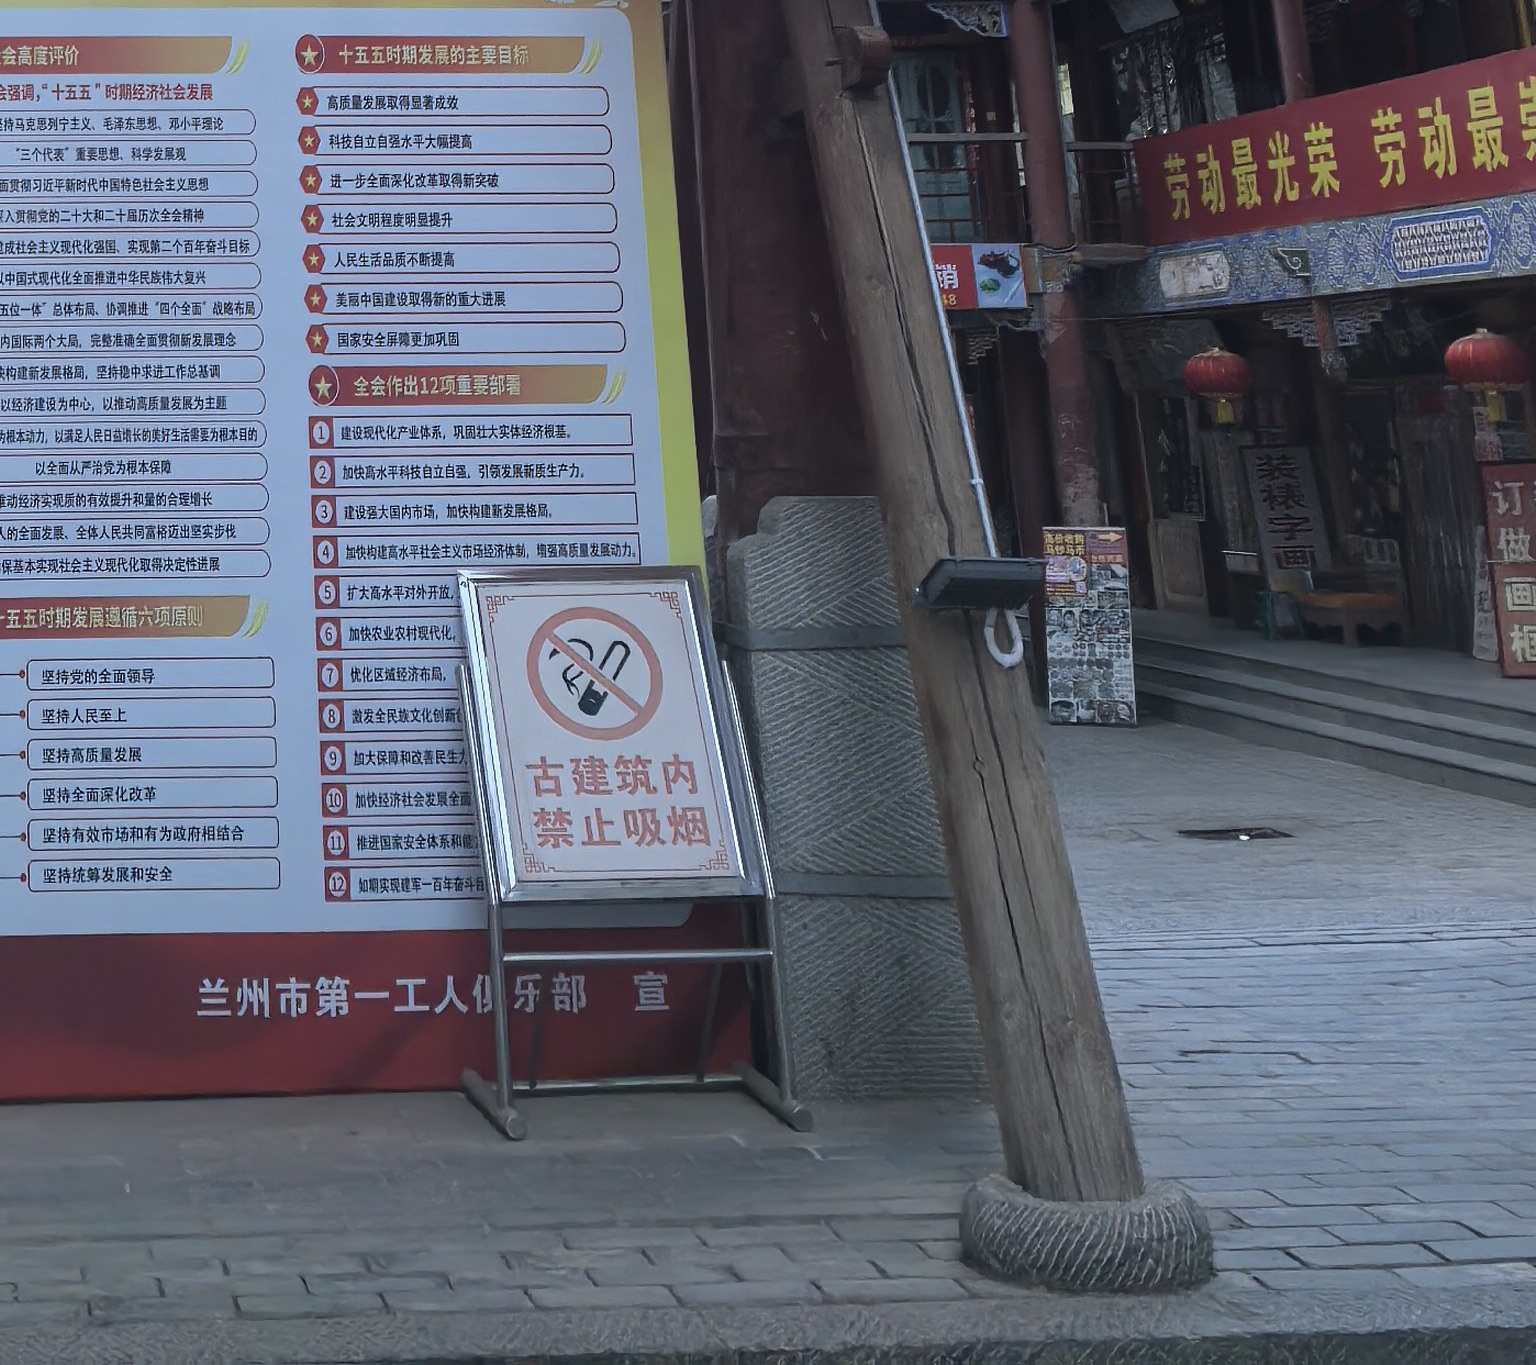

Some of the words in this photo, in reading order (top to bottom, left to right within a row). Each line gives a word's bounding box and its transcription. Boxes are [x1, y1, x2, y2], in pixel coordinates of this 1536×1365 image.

[339, 44, 530, 65] 十五五时期发展的主要目标
[326, 95, 459, 110] 高质量发展取得显著成效
[329, 134, 473, 150] 科技自立自强水平大幅提高
[1164, 121, 1340, 220] 劳动最光荣
[330, 173, 499, 189] 进一步全面深化改革取得新突破
[331, 212, 453, 229] 社会文明程度明显提升
[334, 251, 455, 268] 人民生活品质不断提高
[335, 291, 506, 308] 美丽中国建设取得新的重大进展
[337, 332, 460, 348] 国家安全屏障更加巩固
[354, 374, 522, 398] 全会作出12项重要部署
[318, 426, 325, 440] 1
[35, 460, 172, 475] 以全面从严治党为根本保障
[318, 465, 327, 479] 2
[320, 505, 328, 519] 3
[1256, 453, 1317, 569] 装裱字画
[322, 545, 330, 559] 4
[323, 585, 332, 599] 5
[325, 627, 332, 641] 6
[41, 668, 155, 685] 坚持党的全面领导
[326, 669, 334, 684] 7
[42, 707, 127, 725] 坚持人民至上
[328, 710, 336, 724] 8
[42, 746, 142, 763] 坚持高质量发展
[329, 751, 337, 766] 9
[525, 754, 699, 798] 古建筑内
[43, 786, 157, 804] 坚持全面深化改革
[328, 792, 340, 807] 10
[43, 826, 244, 844] 坚持有效市场和有为政府相结合
[532, 805, 711, 849] 禁止吸烟
[330, 836, 343, 850] 11
[43, 866, 173, 885] 坚持统筹发展和安全
[331, 875, 344, 890] 12
[633, 971, 671, 1011] 宣
